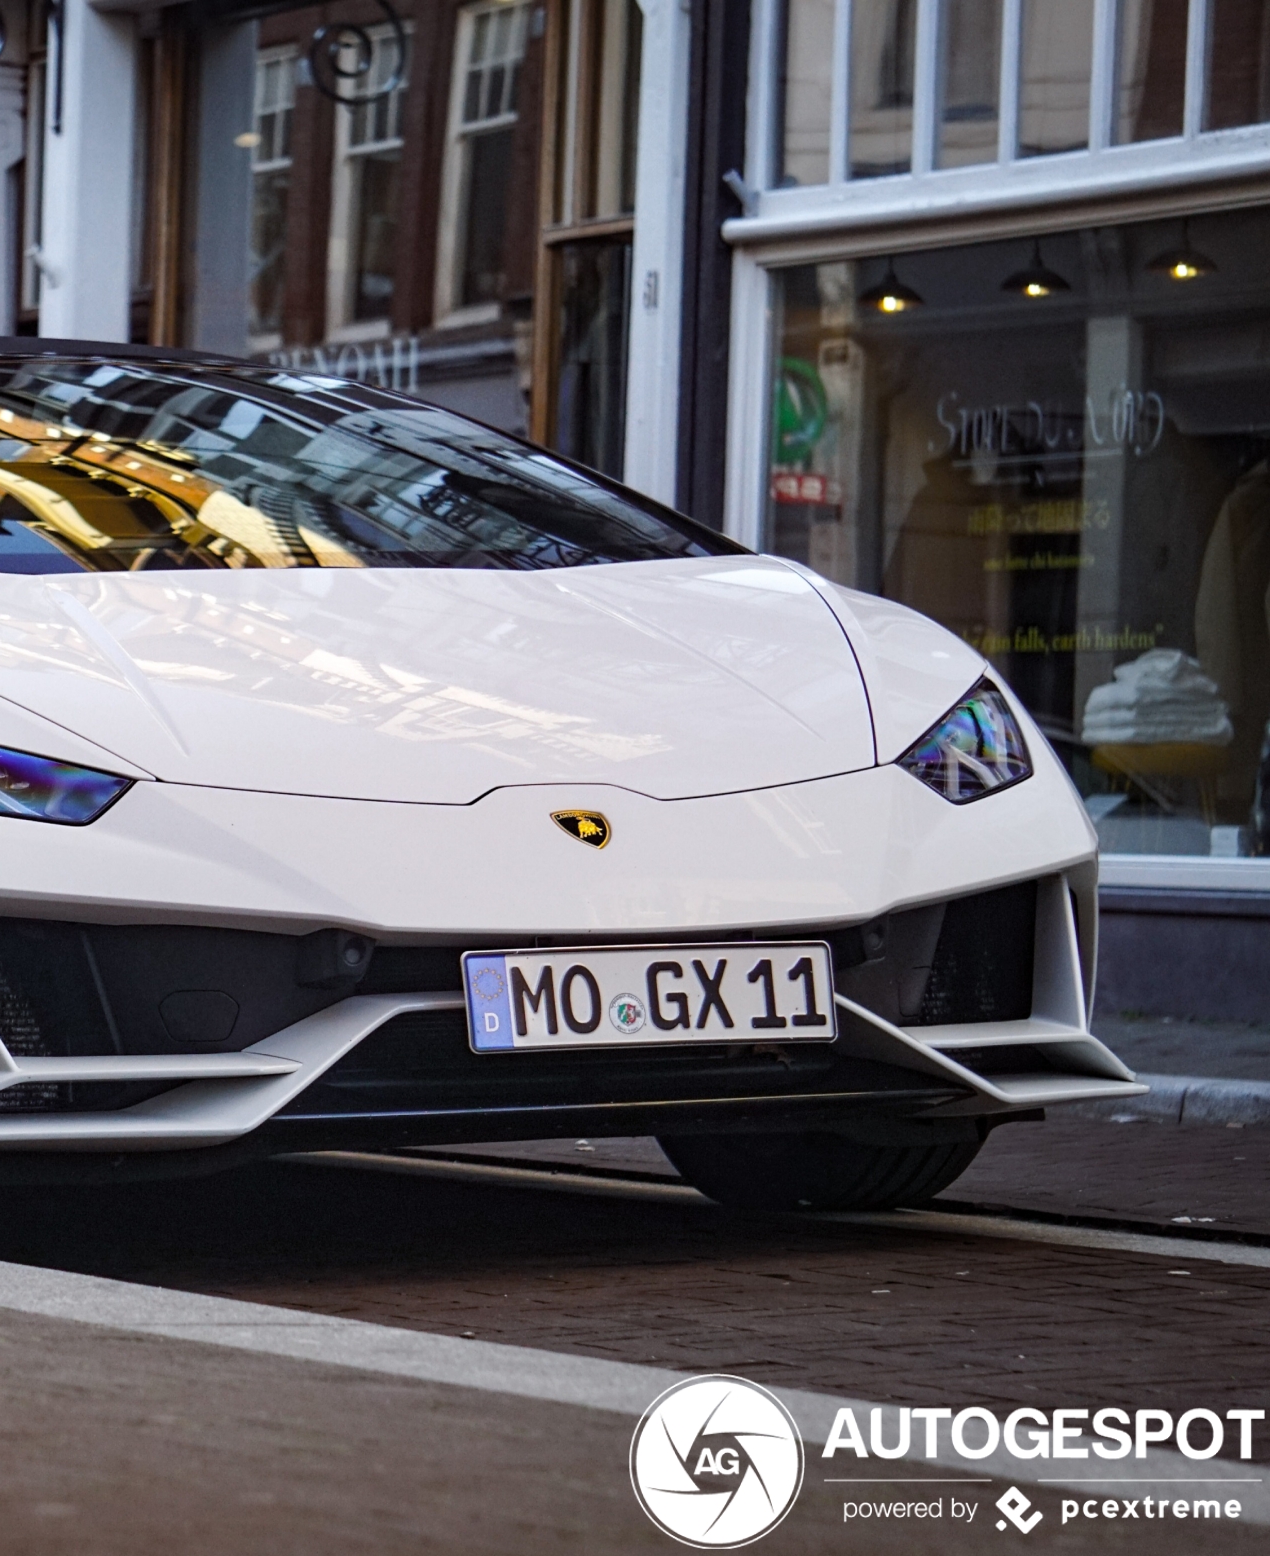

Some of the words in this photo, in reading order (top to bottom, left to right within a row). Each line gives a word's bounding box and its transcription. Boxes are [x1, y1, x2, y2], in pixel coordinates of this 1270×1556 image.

[510, 964, 602, 1036] MO
[646, 957, 735, 1031] GX
[747, 956, 828, 1029] 11
[485, 1012, 500, 1033] D
